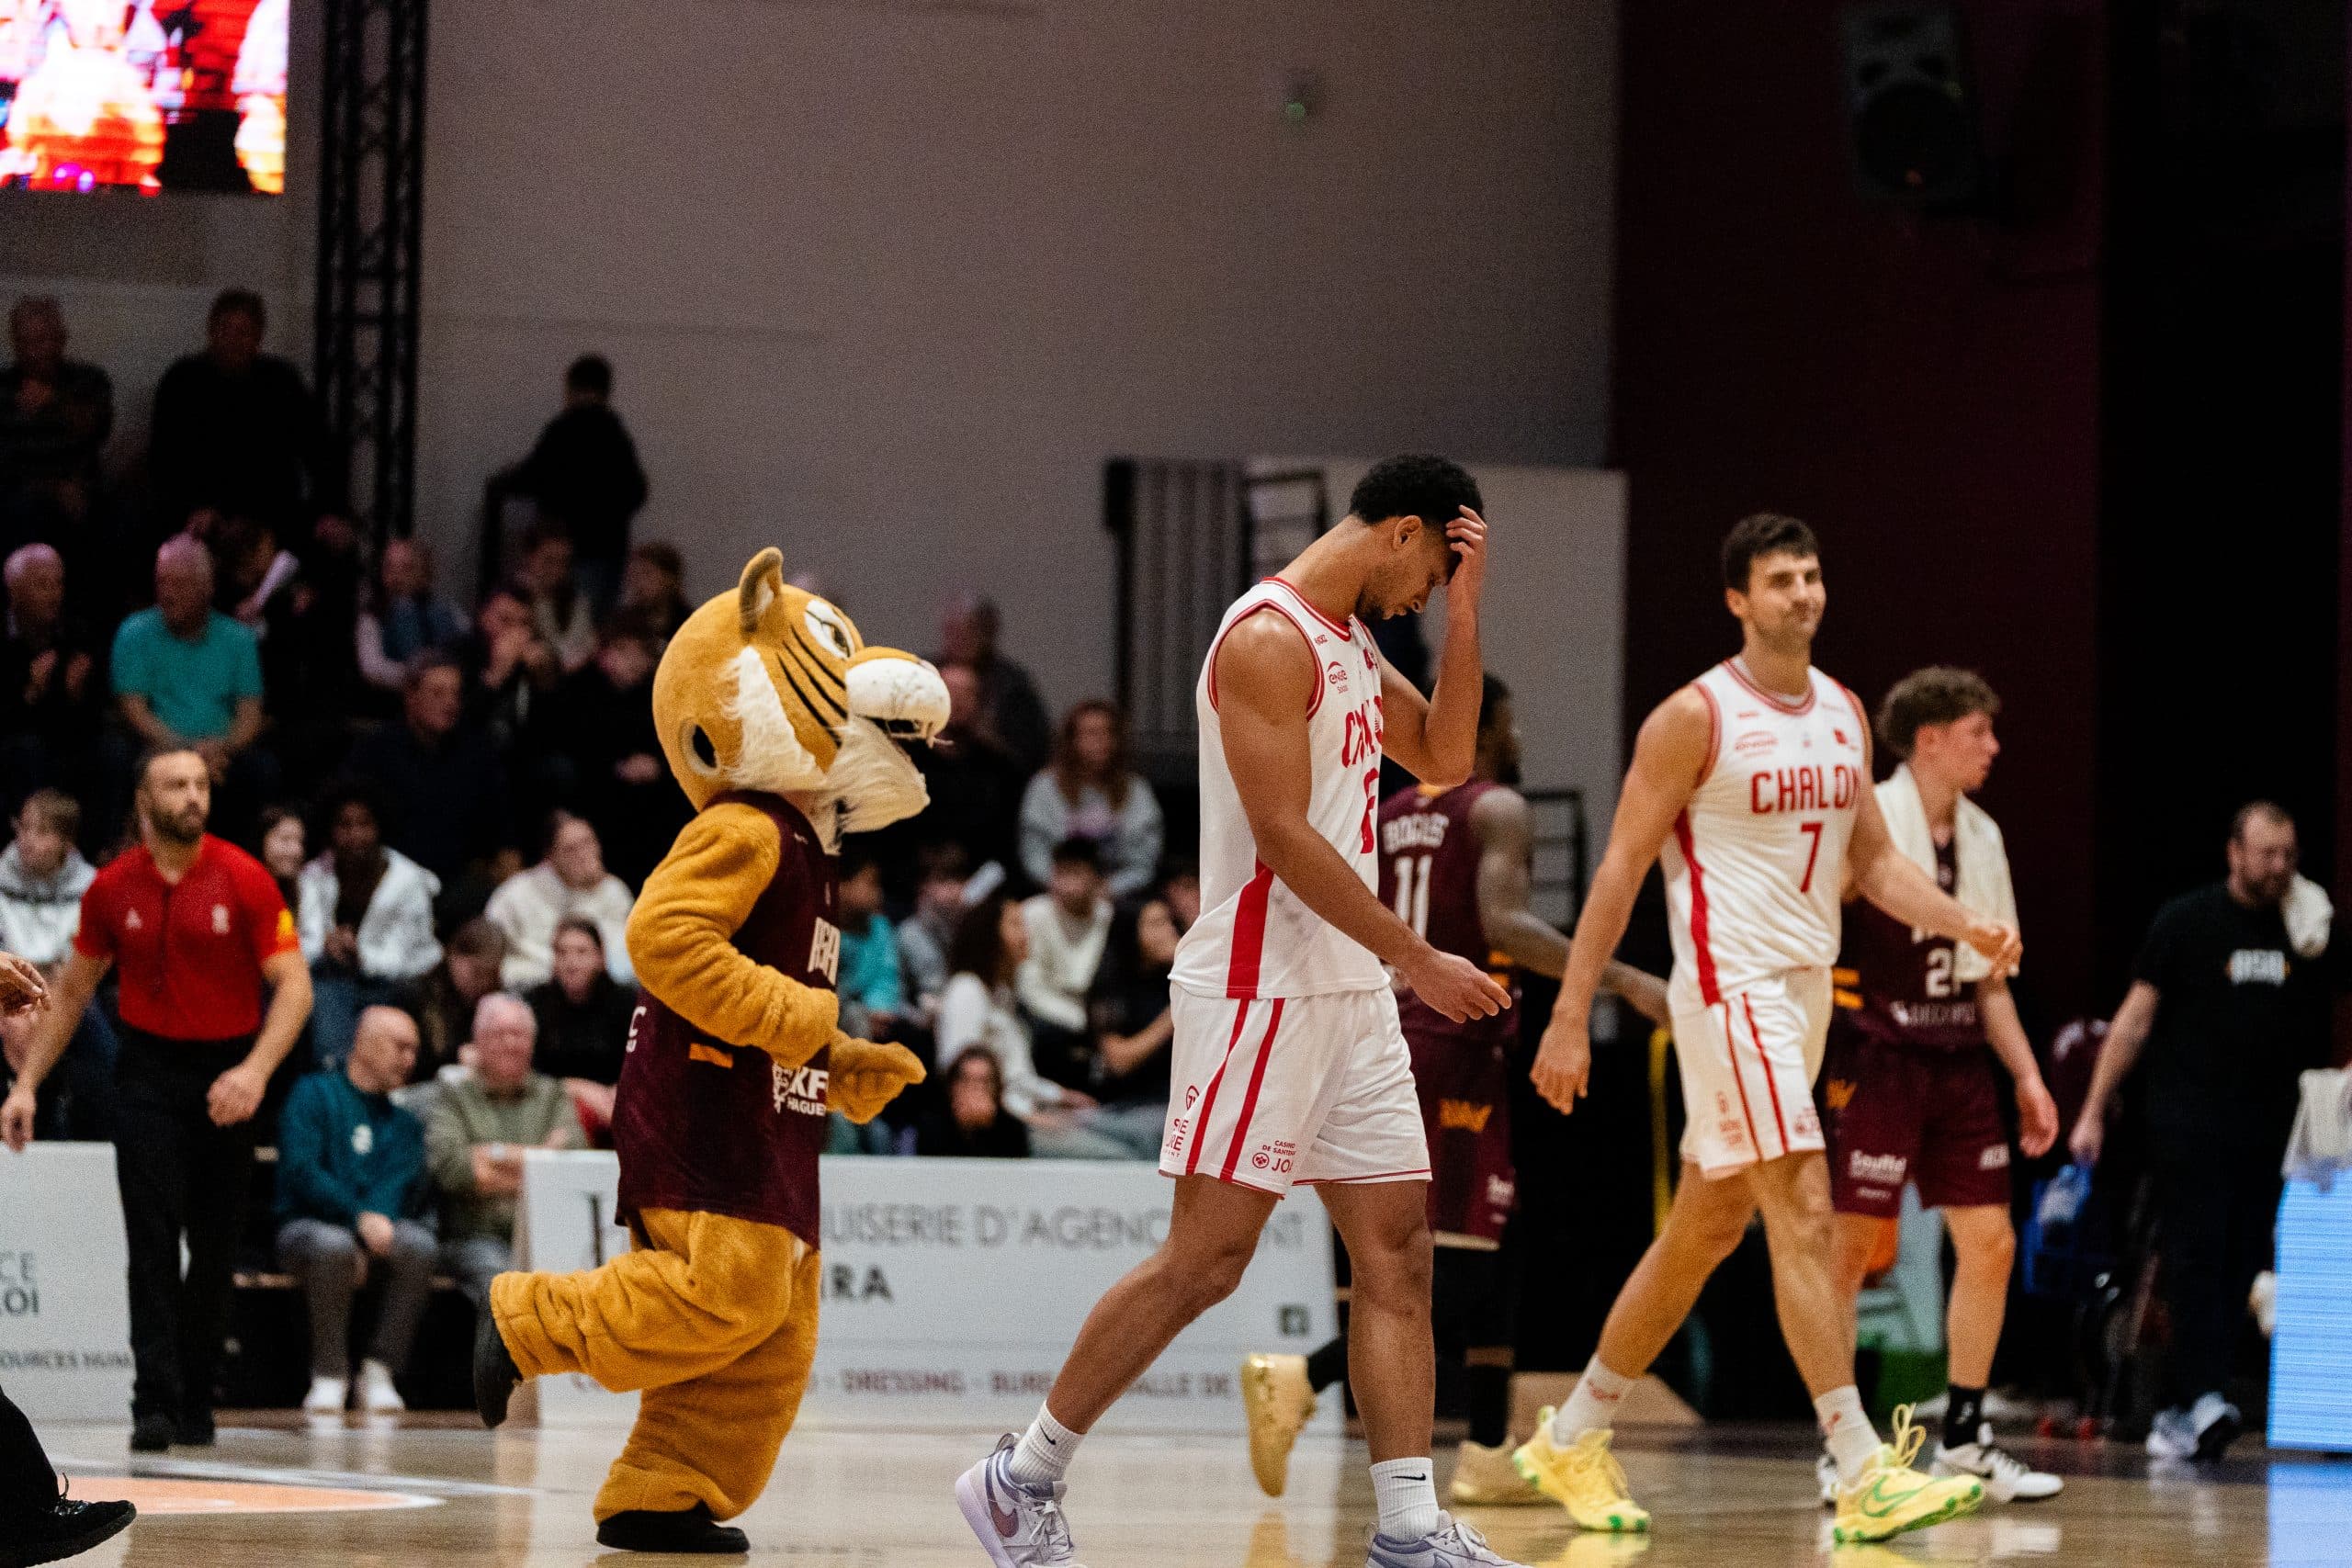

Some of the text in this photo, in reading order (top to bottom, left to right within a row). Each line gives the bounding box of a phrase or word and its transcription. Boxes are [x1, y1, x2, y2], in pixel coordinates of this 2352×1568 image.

[1800, 820, 1823, 894] 7
[1394, 855, 1432, 942] 11
[1272, 1157, 1294, 1174] JO
